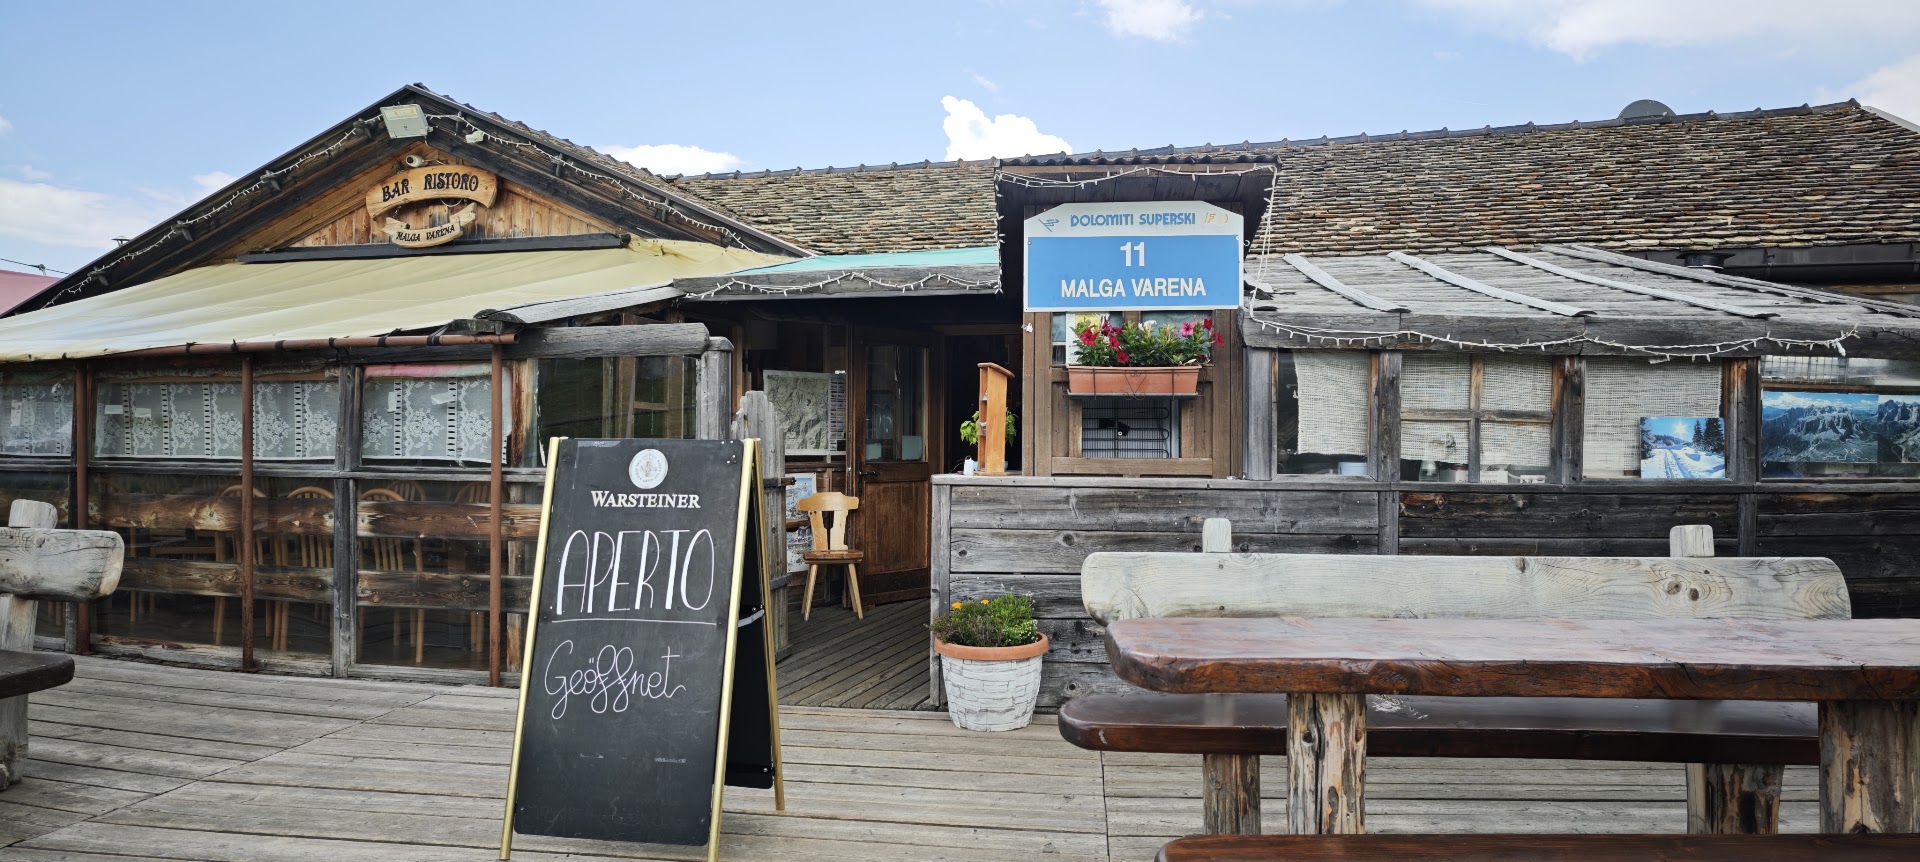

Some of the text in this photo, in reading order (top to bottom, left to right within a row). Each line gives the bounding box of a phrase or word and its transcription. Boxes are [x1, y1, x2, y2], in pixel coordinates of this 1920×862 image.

[382, 172, 479, 202] BAR RISTORO
[1070, 213, 1134, 227] DOLOMITI
[1139, 212, 1196, 225] SUPERSKI
[395, 224, 456, 242] MALGA VARENA
[1119, 241, 1146, 267] 11
[1060, 277, 1207, 298] MALGA VARENA
[590, 490, 701, 509] WARSTEINER
[556, 529, 715, 616] APERTO
[544, 639, 687, 720] Geöffnet
